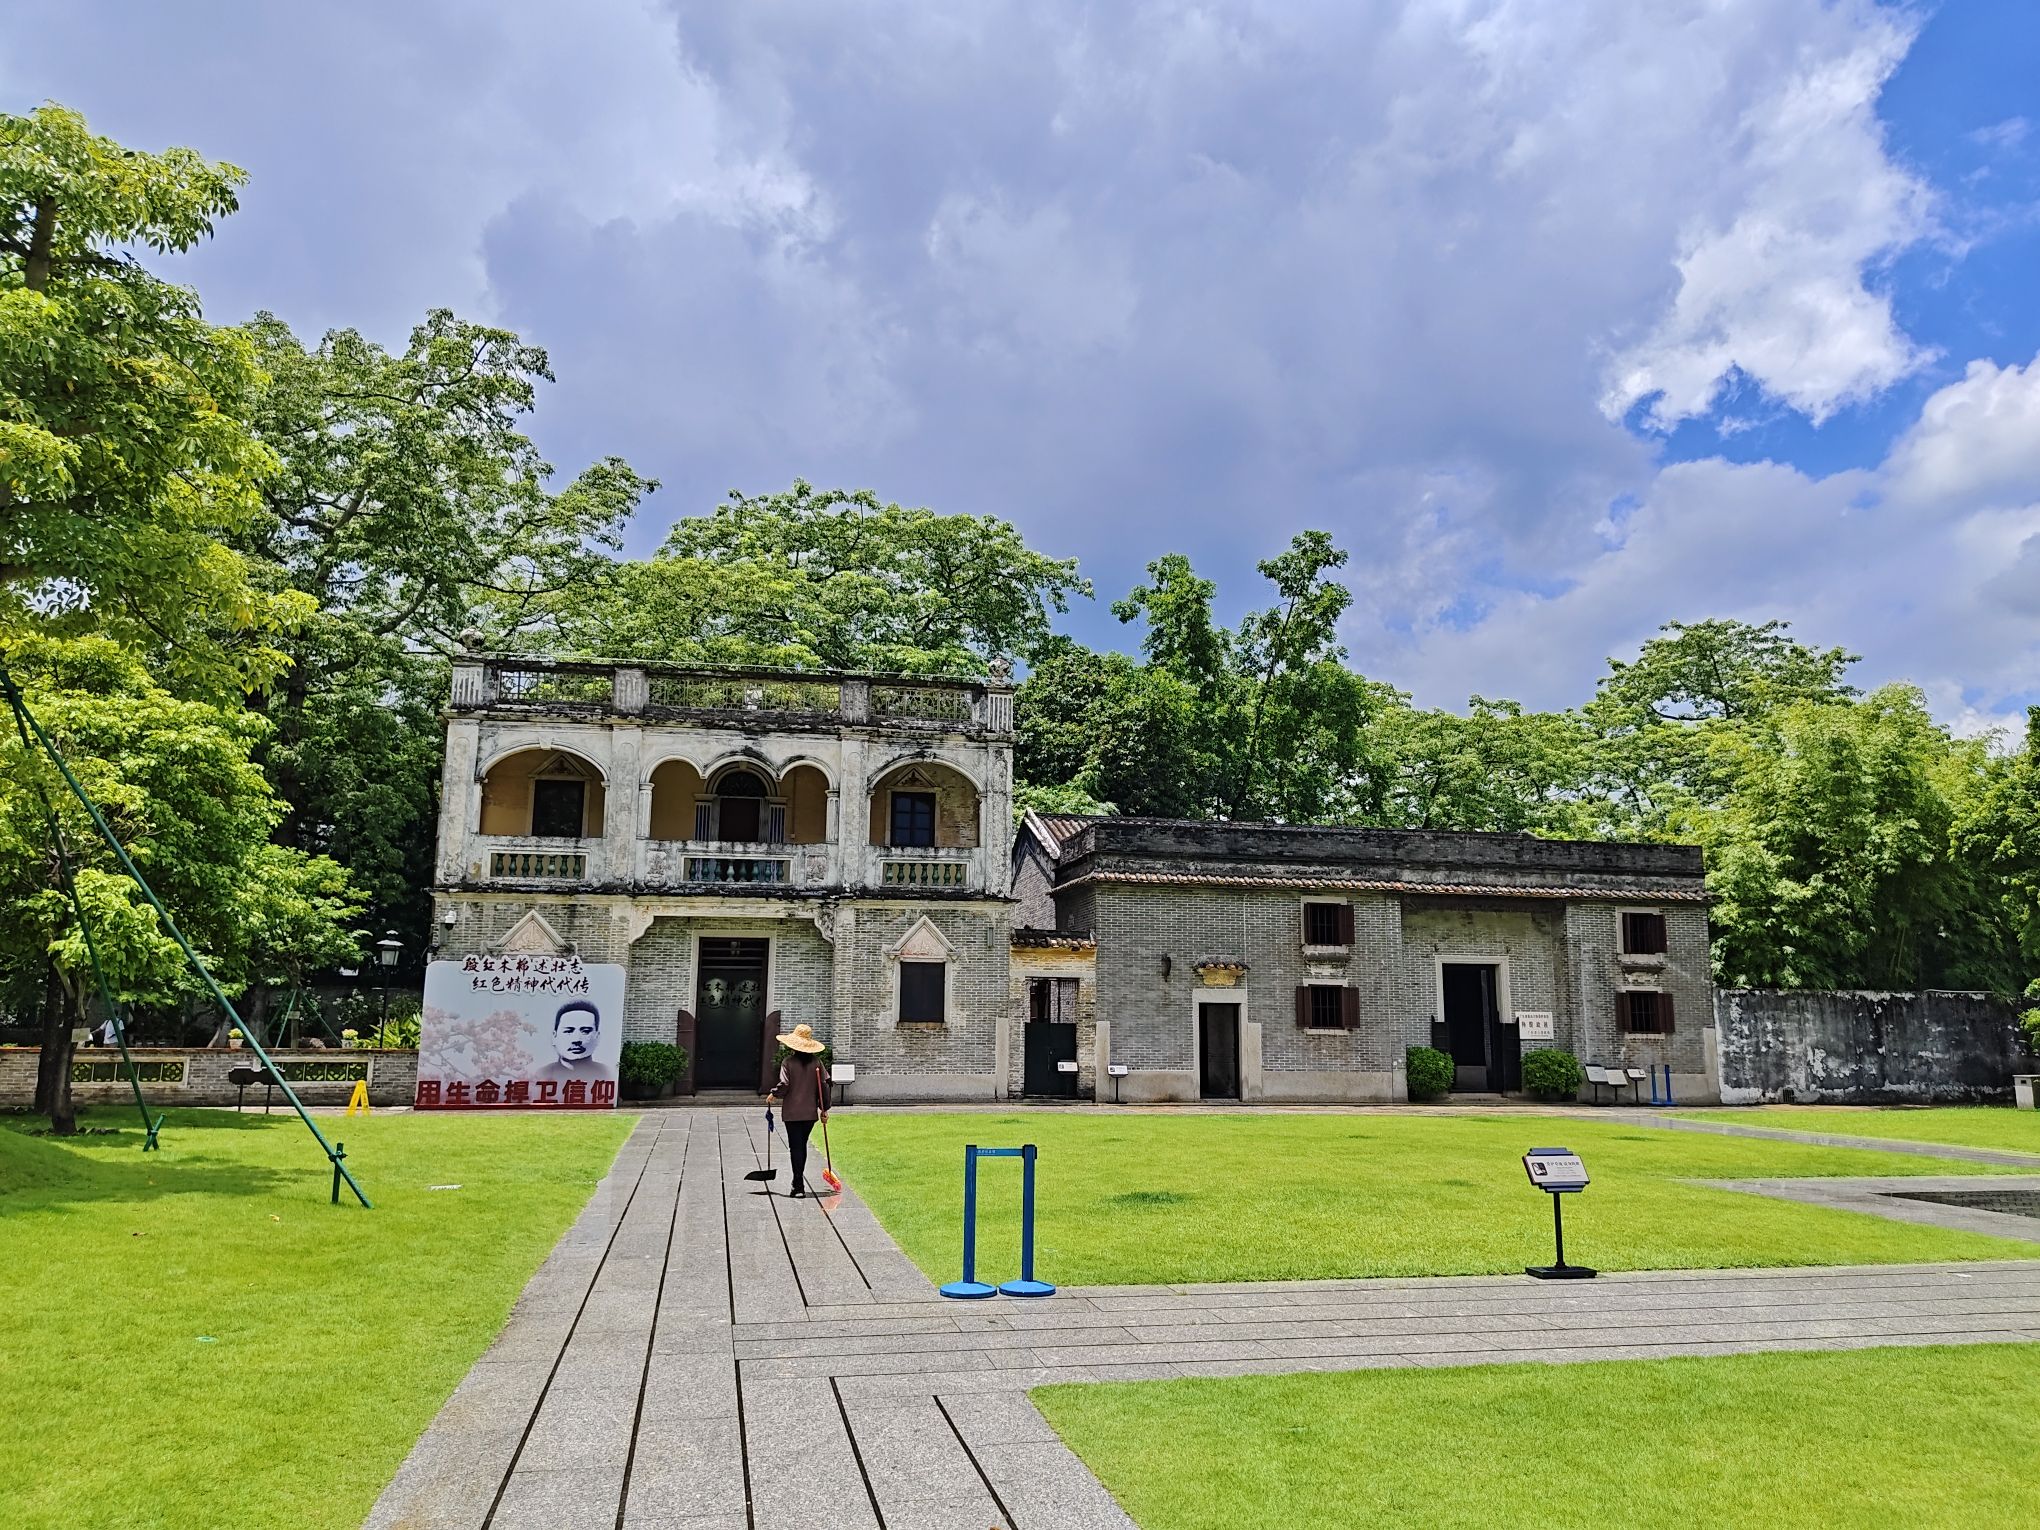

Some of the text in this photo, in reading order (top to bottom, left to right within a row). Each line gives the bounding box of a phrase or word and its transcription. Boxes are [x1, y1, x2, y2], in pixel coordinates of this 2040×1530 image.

[472, 976, 591, 994] 红色精神代代传
[416, 1078, 616, 1105] 用生命捍卫信仰
